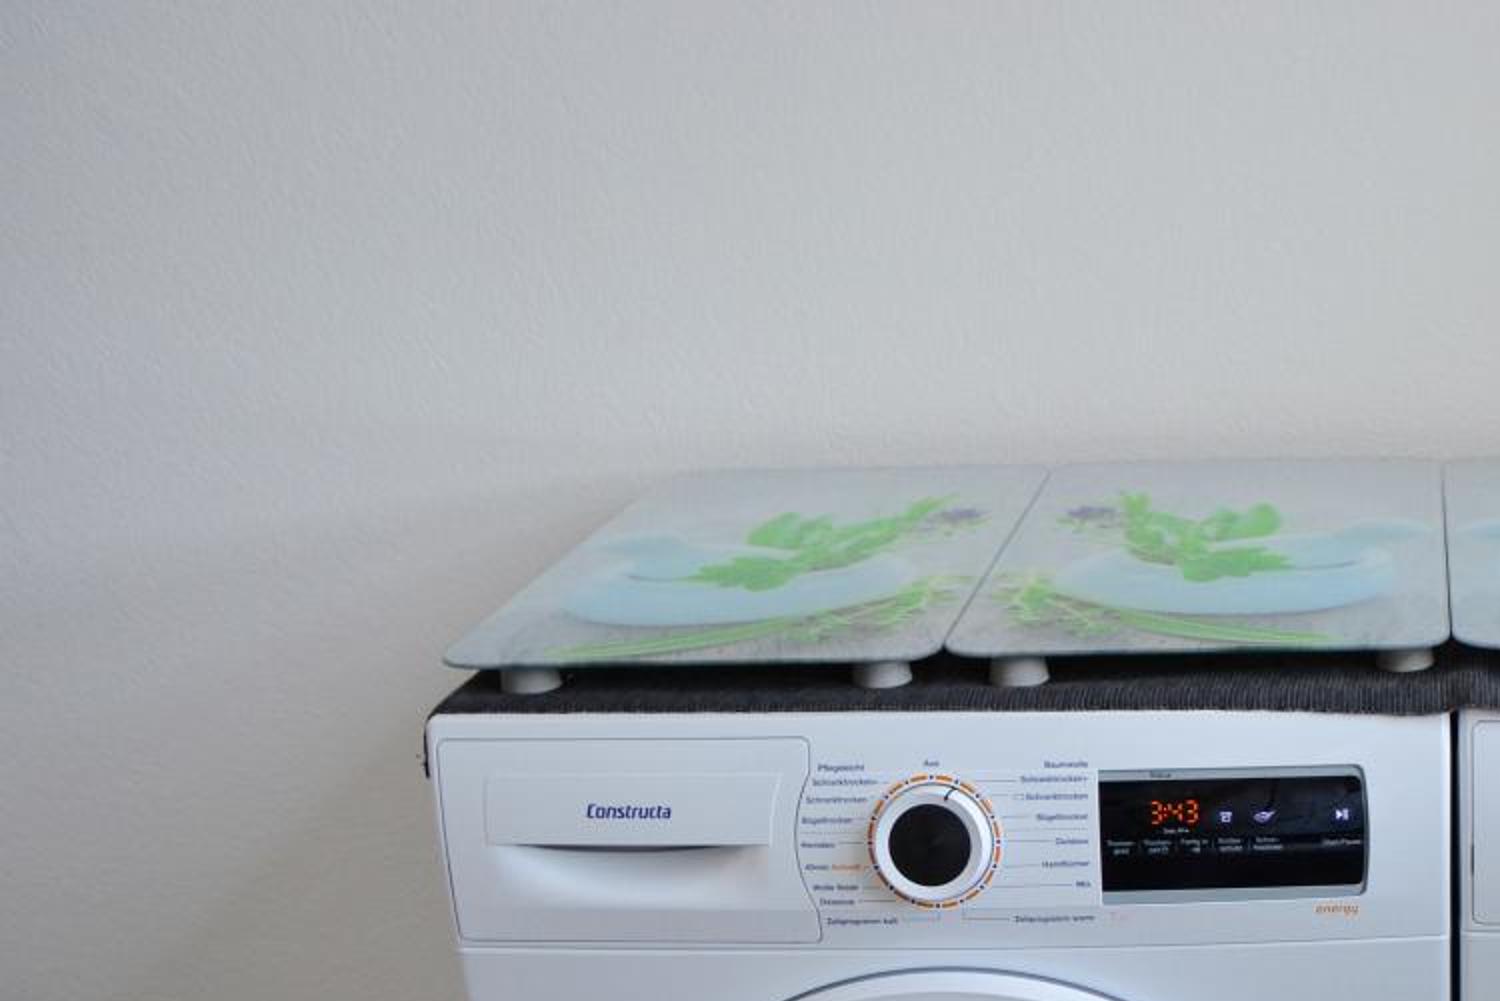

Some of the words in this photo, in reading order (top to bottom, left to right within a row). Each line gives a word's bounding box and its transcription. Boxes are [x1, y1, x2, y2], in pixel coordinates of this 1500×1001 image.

[586, 803, 672, 820] Constructa
[1151, 800, 1199, 825] 3:43
[1315, 903, 1359, 916] energy
